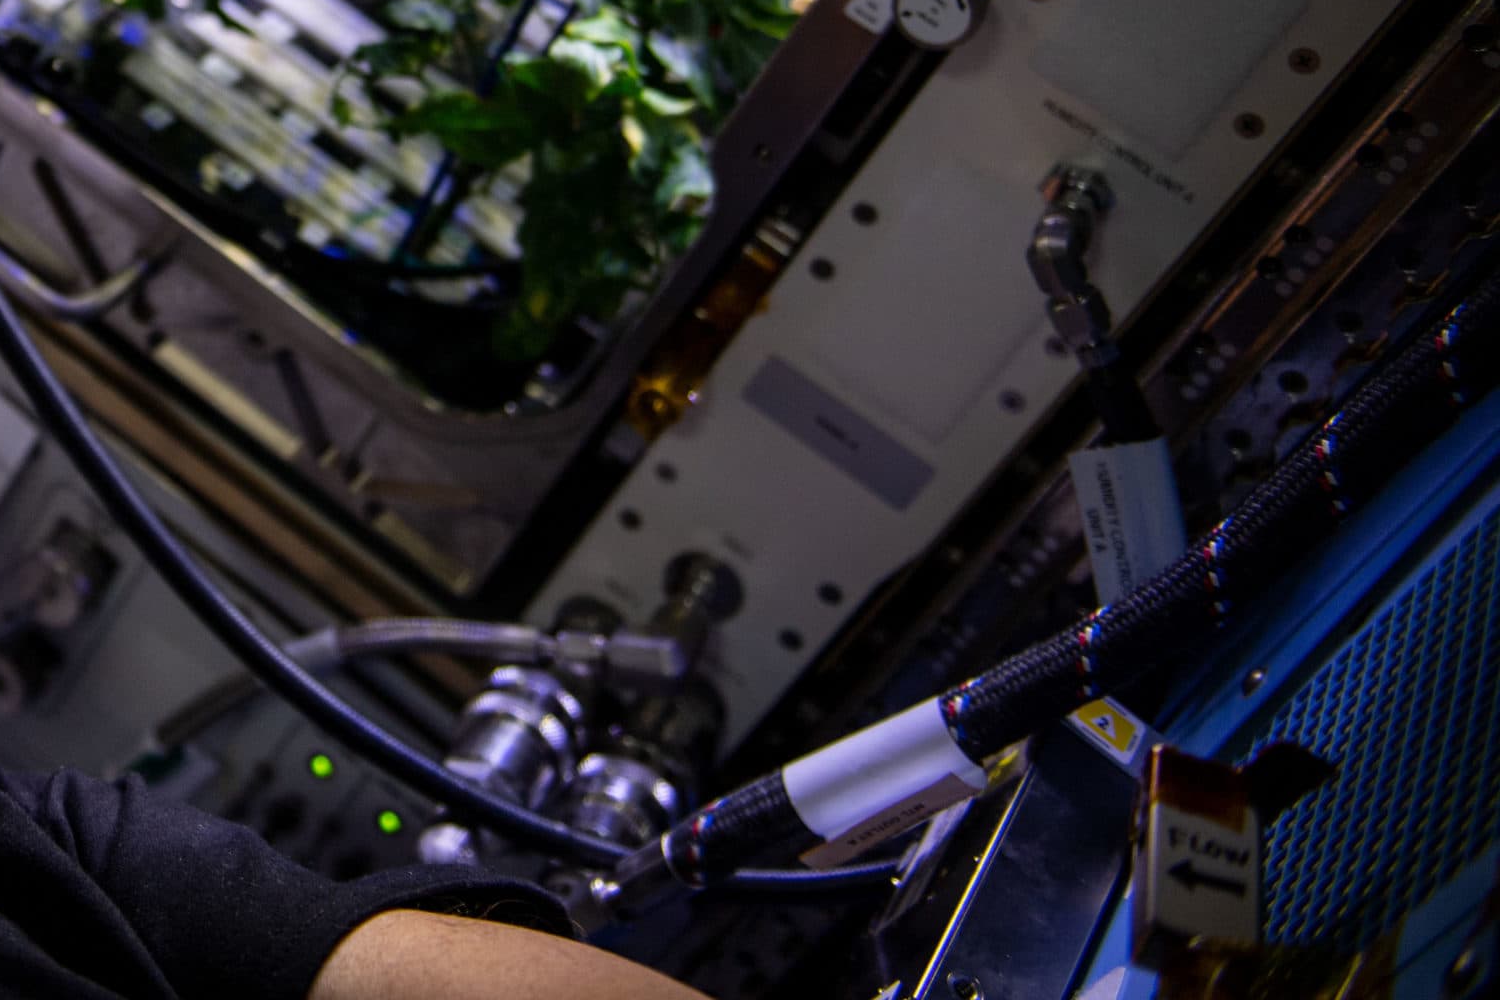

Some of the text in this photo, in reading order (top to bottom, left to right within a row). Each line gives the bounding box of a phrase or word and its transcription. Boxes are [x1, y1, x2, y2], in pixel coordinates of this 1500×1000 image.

[1087, 508, 1105, 540] UNIT
[1110, 529, 1134, 597] CONTRO
[1168, 825, 1250, 868] FLOW
